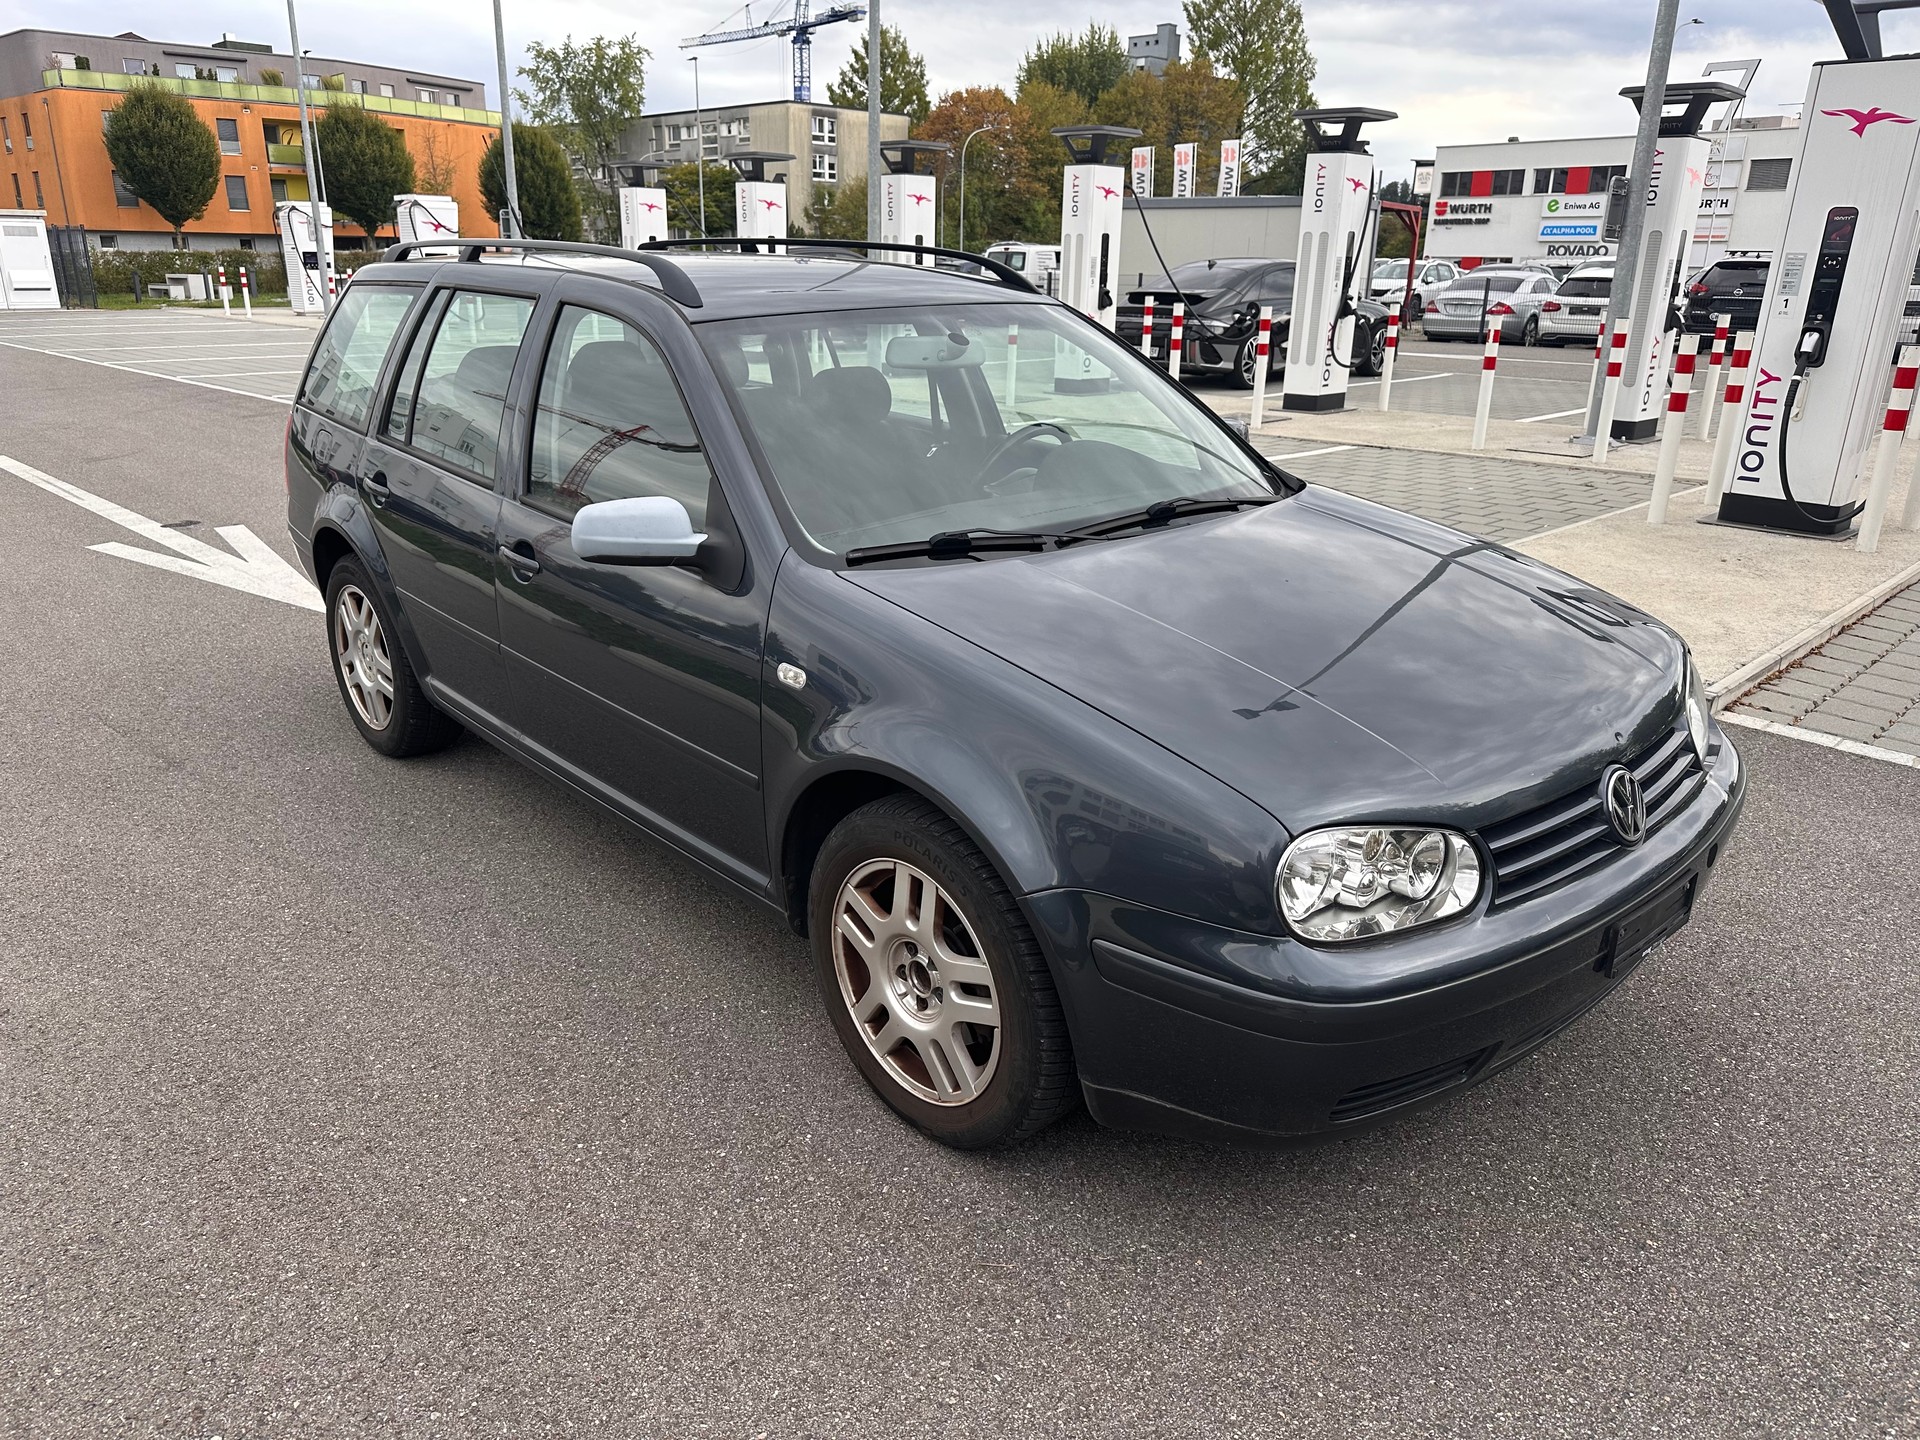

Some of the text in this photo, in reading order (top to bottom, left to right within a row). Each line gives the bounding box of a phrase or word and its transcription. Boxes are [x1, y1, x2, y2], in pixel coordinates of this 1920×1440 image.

[886, 182, 894, 221] IONITY
[1071, 173, 1080, 217] IONITY
[1314, 163, 1327, 213] IONITY
[1564, 202, 1587, 210] Eniwa
[1588, 201, 1601, 210] AG
[1449, 203, 1492, 214] WÜRTH
[1546, 244, 1609, 257] ROVADO
[1783, 298, 1789, 309] 1
[1641, 335, 1660, 413] IONITY
[1736, 367, 1782, 483] IONITY
